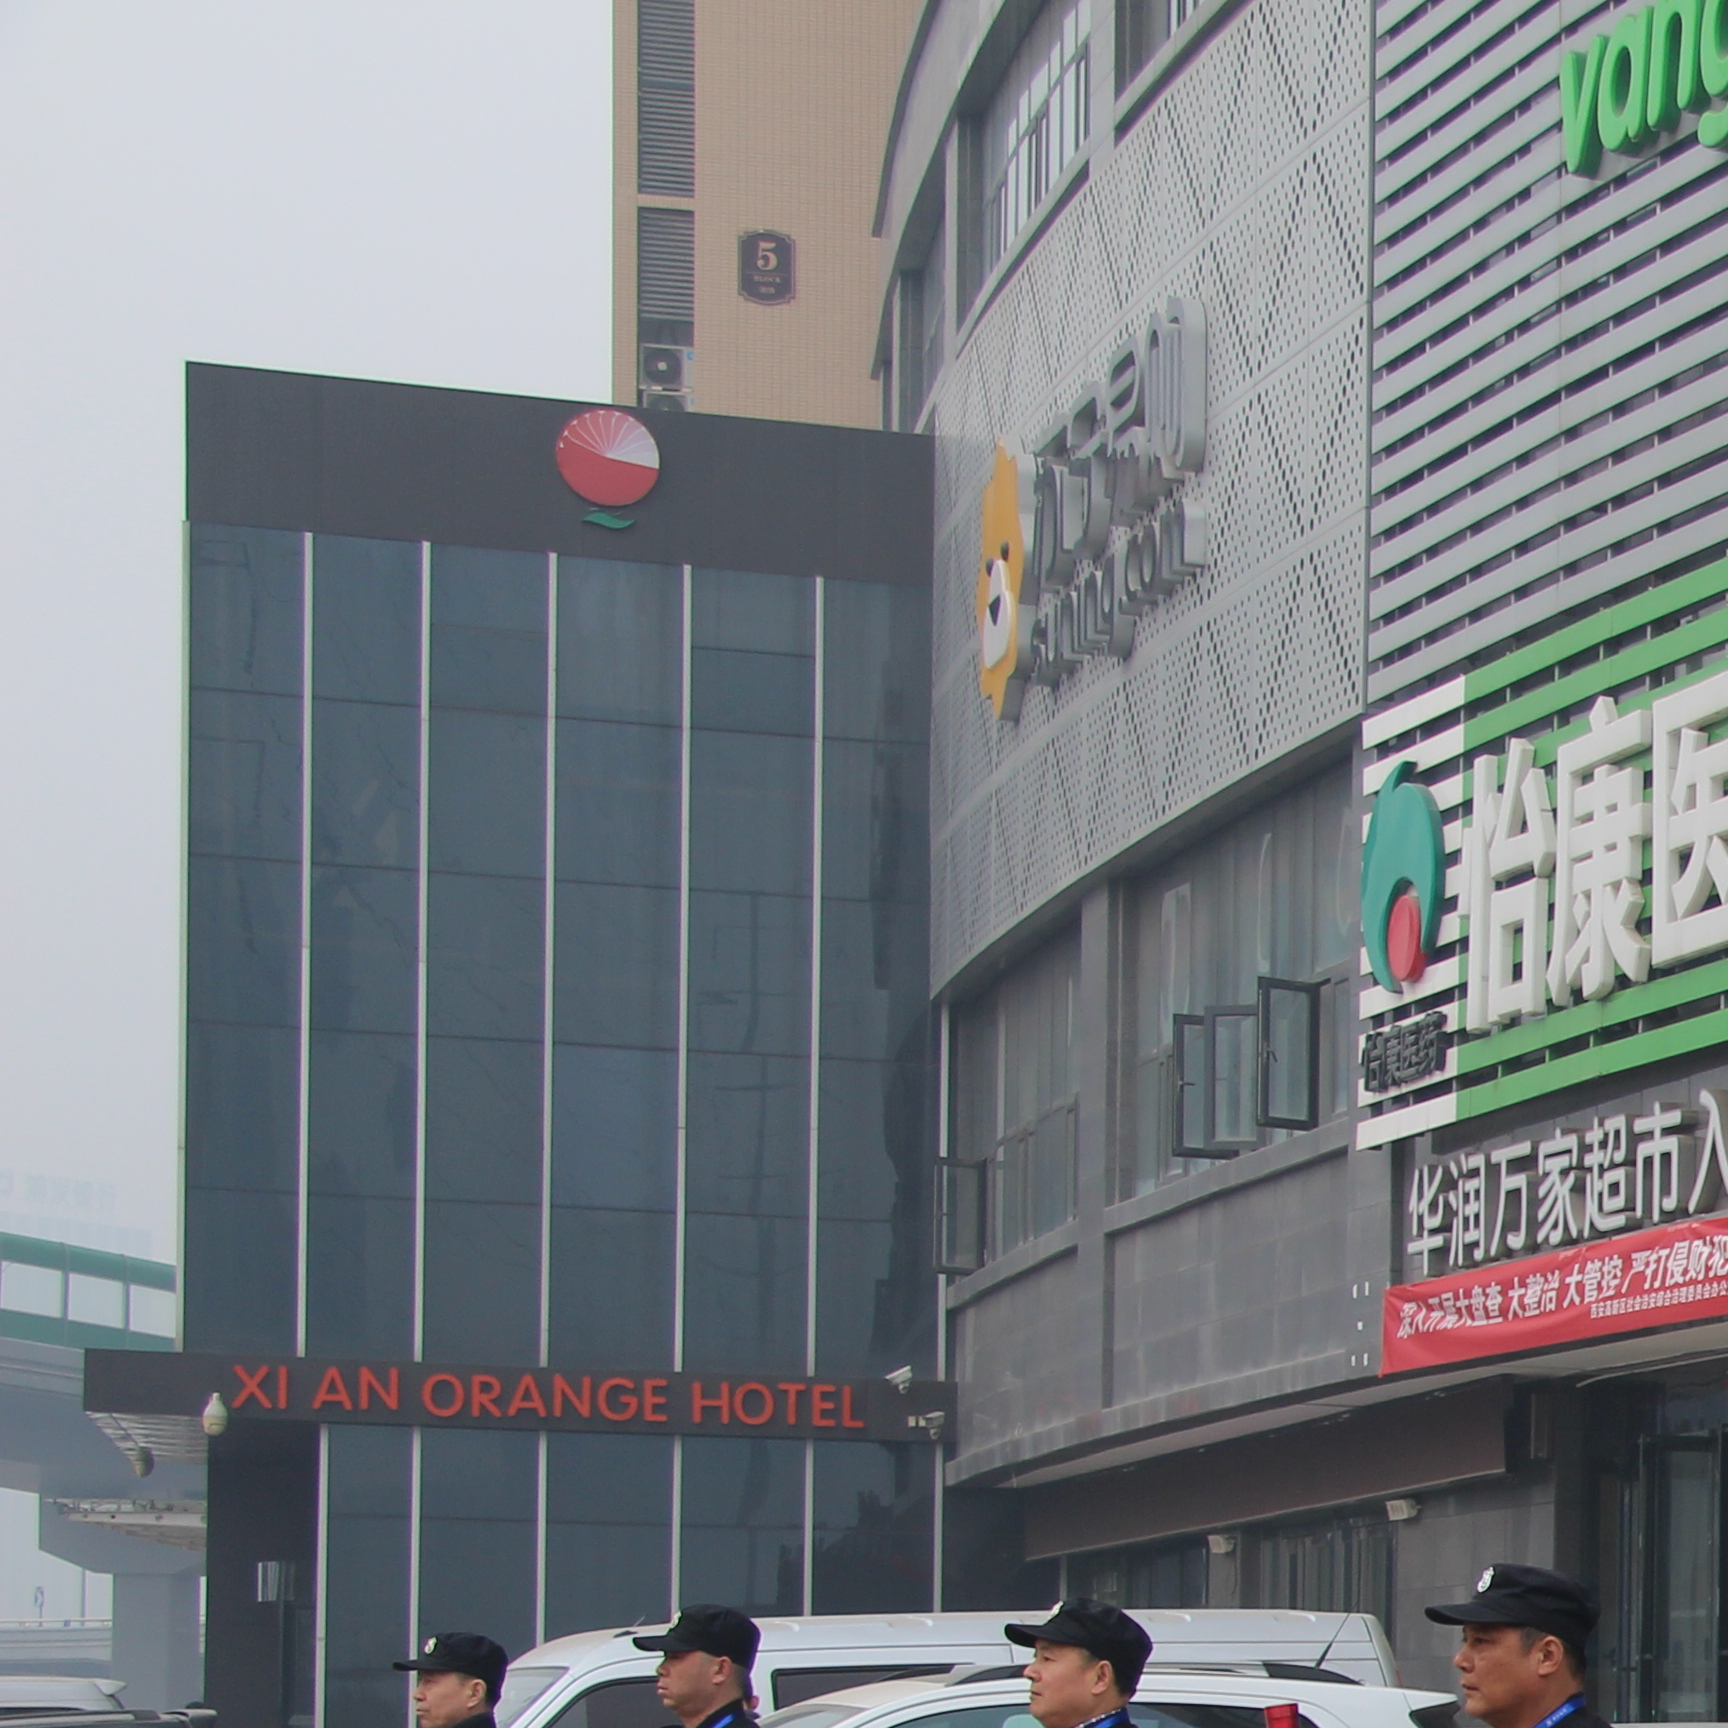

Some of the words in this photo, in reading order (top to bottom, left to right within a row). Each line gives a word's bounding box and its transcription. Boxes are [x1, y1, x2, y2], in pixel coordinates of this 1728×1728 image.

[756, 240, 778, 270] 5
[1507, 1272, 1560, 1320] 大整治
[1562, 1252, 1622, 1307] 大管控
[231, 1364, 288, 1410] XI
[311, 1366, 399, 1412] AN
[421, 1373, 668, 1424] ORANGE
[691, 1382, 865, 1430] HOTEL
